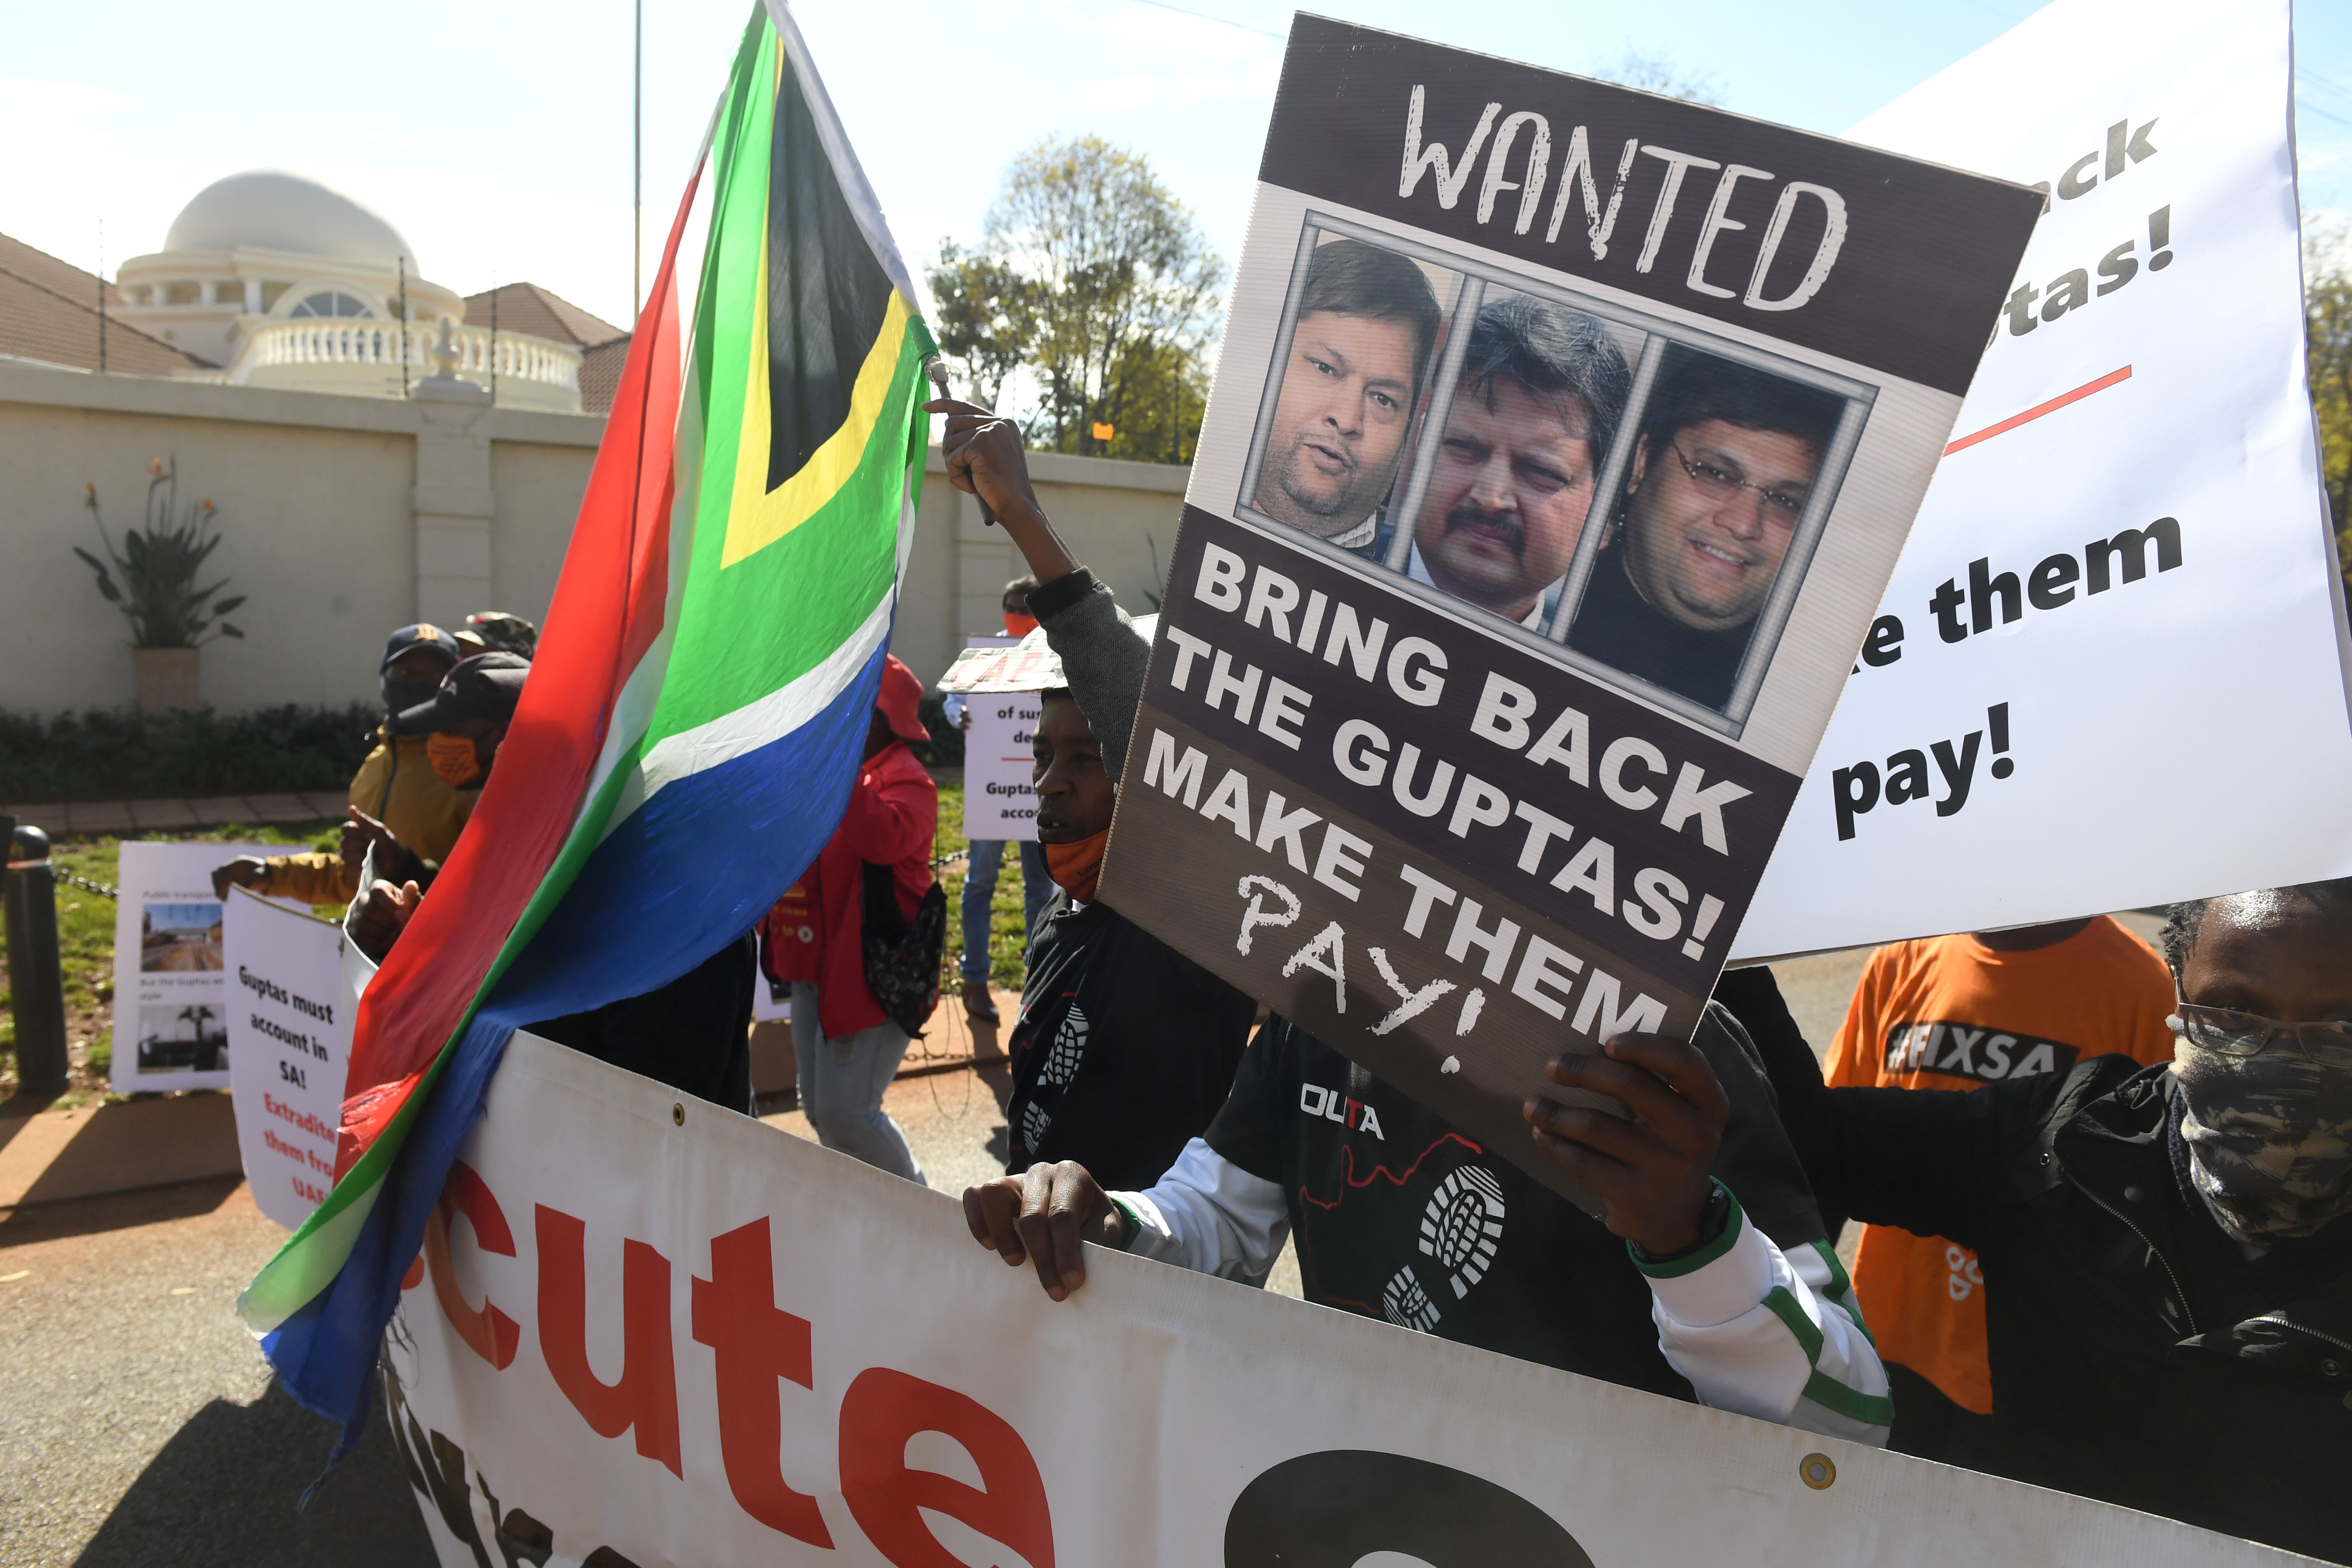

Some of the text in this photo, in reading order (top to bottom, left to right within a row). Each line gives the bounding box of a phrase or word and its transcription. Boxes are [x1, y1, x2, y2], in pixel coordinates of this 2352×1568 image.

[1399, 84, 1848, 311] WANTED
[1986, 204, 2174, 351] tas!
[1930, 517, 2182, 643] them
[997, 706, 1014, 719] of
[1194, 542, 1753, 856] BRING BACK
[1001, 809, 1038, 819] acco
[1167, 625, 1725, 962] THE GUPTAS!
[1832, 702, 2014, 841] pay!
[1143, 728, 1668, 1046] MAKE THEM
[239, 965, 333, 1025] Guptas must
[1237, 874, 1486, 1073] PAY!
[251, 1013, 328, 1062] account in
[280, 1060, 306, 1090] SA!
[1888, 1024, 2055, 1081] #FIXSA
[264, 1092, 335, 1144] Extradite
[264, 1130, 333, 1177] them fro
[1300, 1083, 1385, 1141] OUTA
[401, 1158, 1055, 1568] cute
